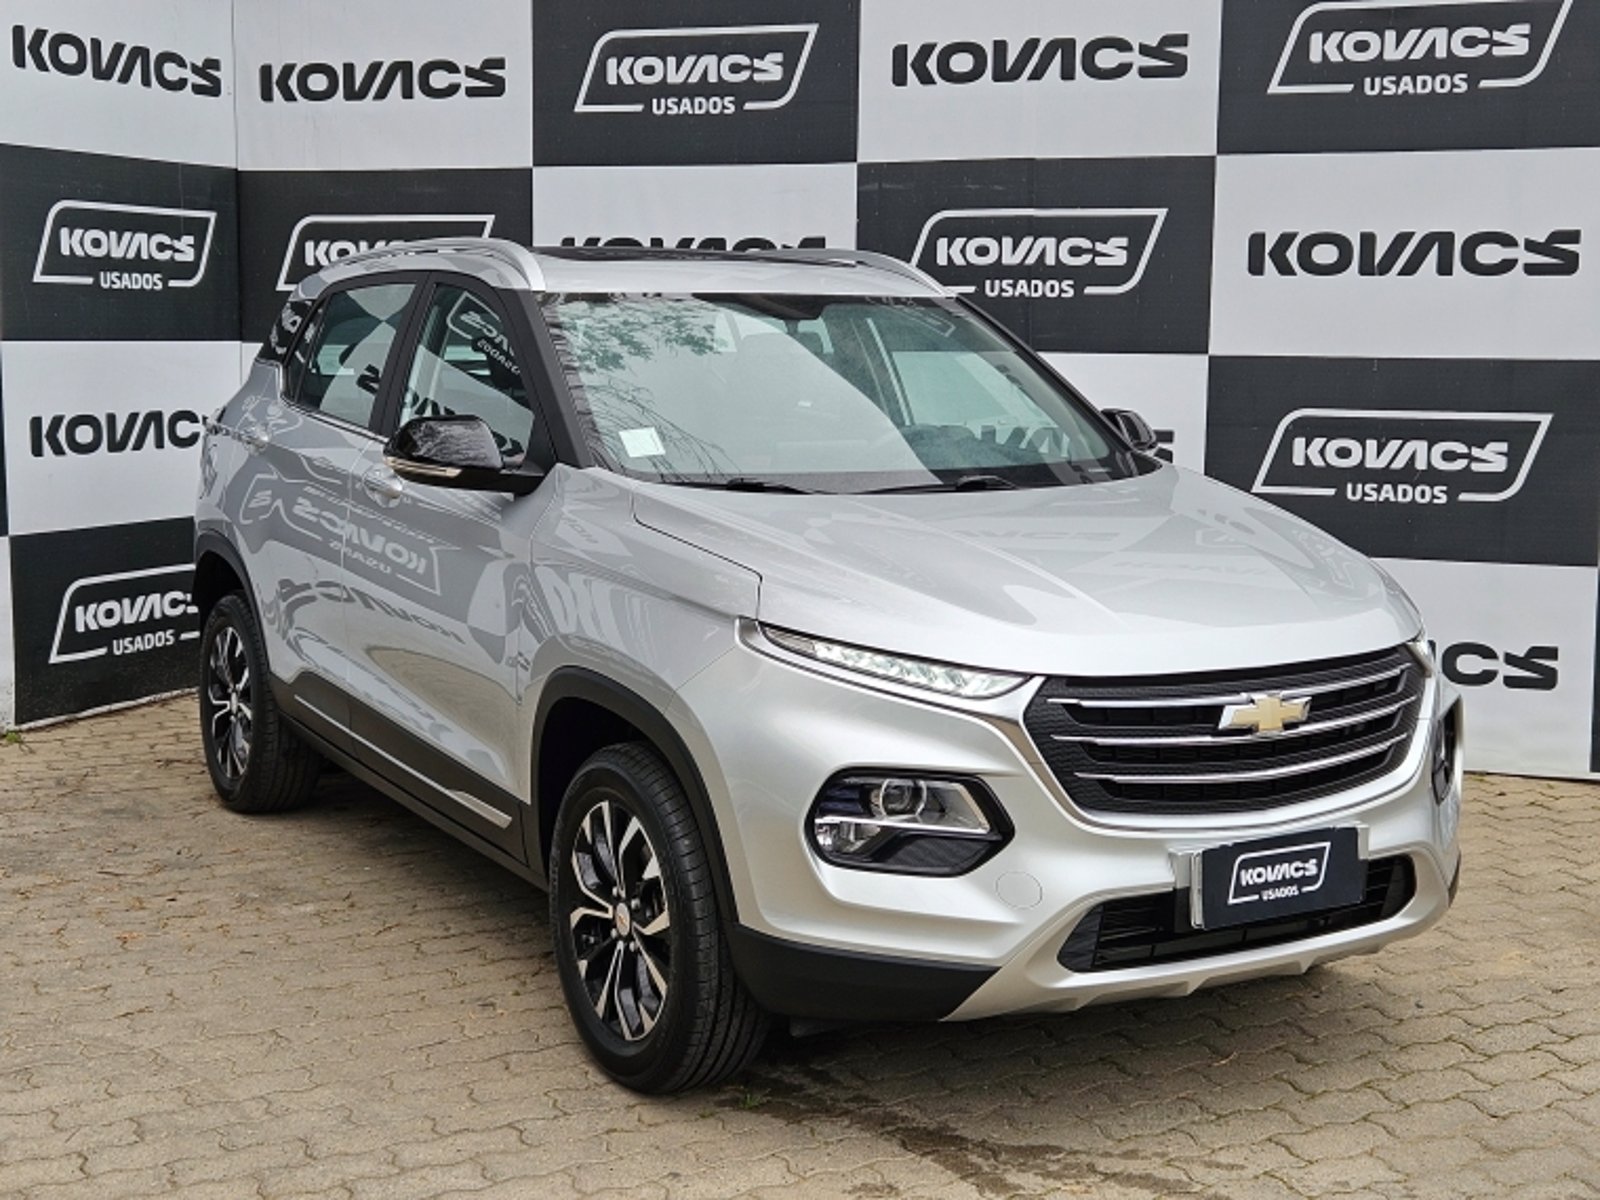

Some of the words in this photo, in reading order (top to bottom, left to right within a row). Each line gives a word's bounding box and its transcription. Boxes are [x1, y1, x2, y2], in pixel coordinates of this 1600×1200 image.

[892, 33, 1189, 87] KOVACS
[1308, 23, 1532, 65] KOVACS
[12, 25, 222, 98] KOVACS
[606, 52, 785, 86] KOVACS
[259, 57, 506, 103] KOVACS
[1363, 74, 1469, 96] USADOS
[652, 97, 736, 116] USADOS
[59, 227, 195, 263] KOVACS
[936, 236, 1129, 266] KOVACS
[1248, 229, 1582, 277] KOVACS
[99, 271, 163, 292] USADOS
[984, 279, 1075, 298] USADOS
[29, 410, 205, 458] KOVAC
[1292, 437, 1508, 473] KOVACS
[1346, 483, 1448, 504] USADOS
[112, 628, 176, 656] USADOS
[1240, 858, 1318, 887] KOVACS
